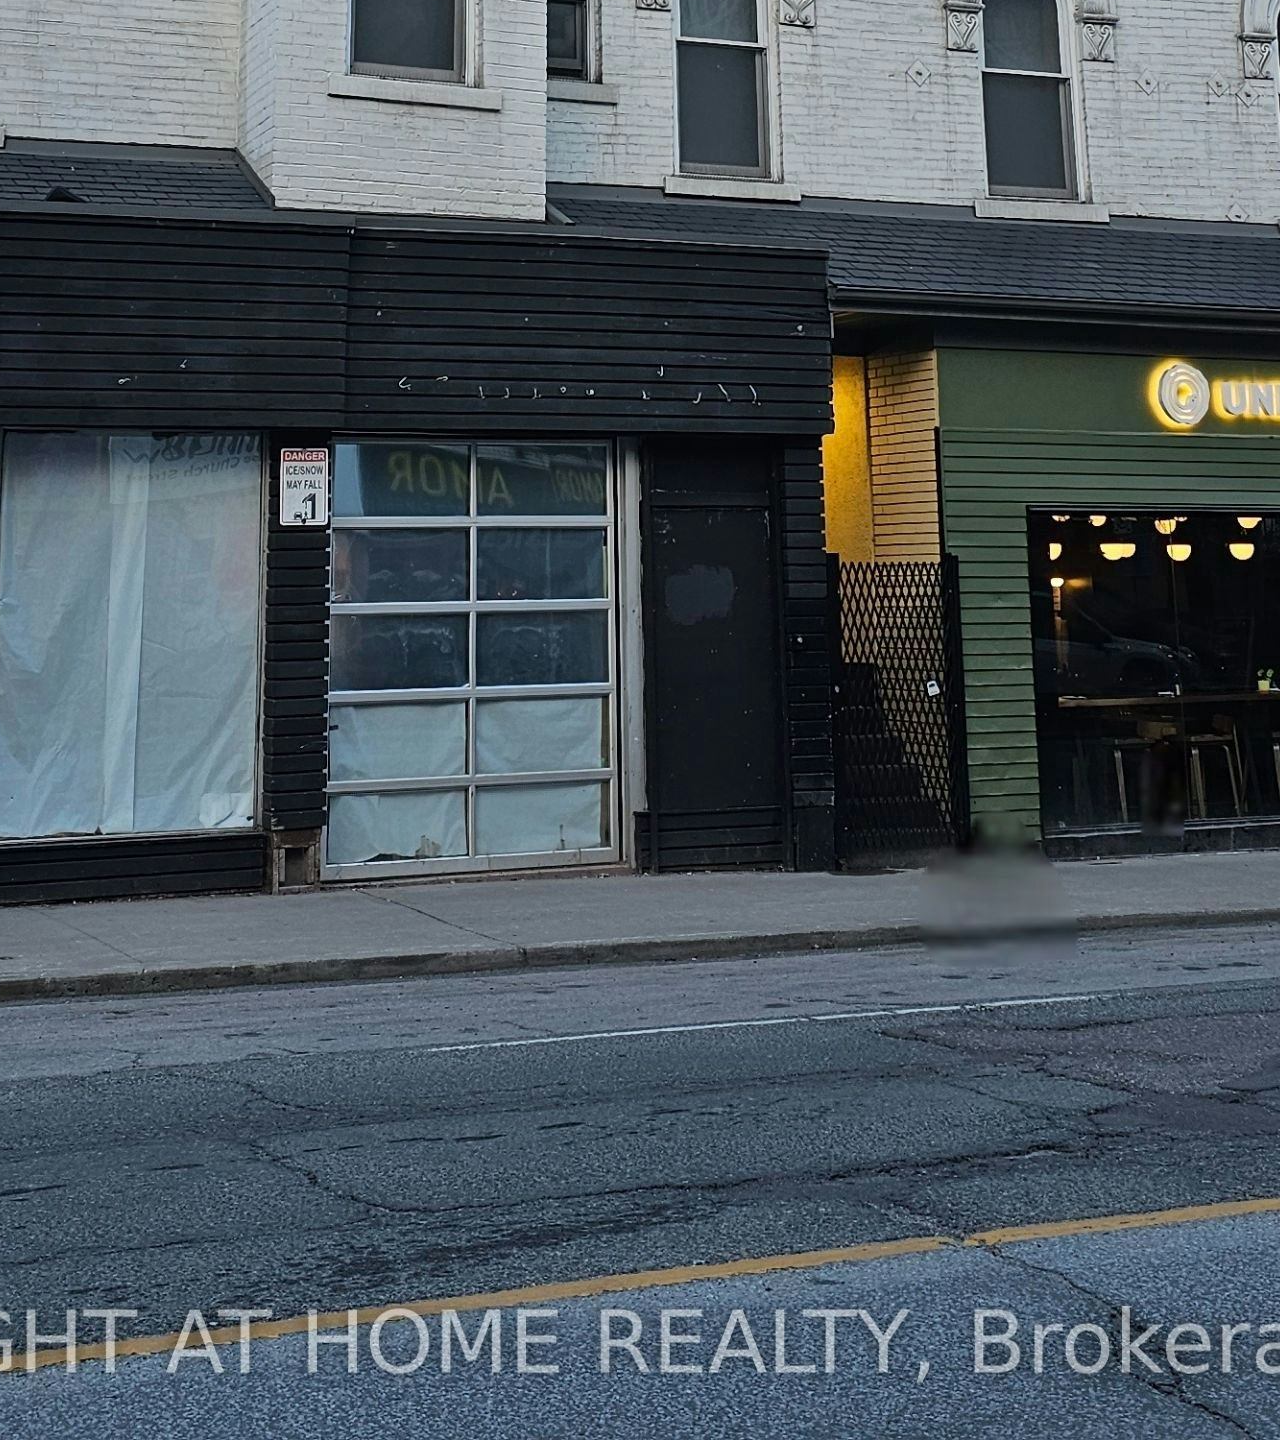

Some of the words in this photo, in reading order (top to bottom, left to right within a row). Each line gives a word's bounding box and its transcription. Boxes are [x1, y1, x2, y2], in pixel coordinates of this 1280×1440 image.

[284, 451, 326, 461] DANGER
[285, 465, 324, 476] ICE/SNOW
[286, 480, 302, 490] MAY
[304, 479, 323, 490] FALL
